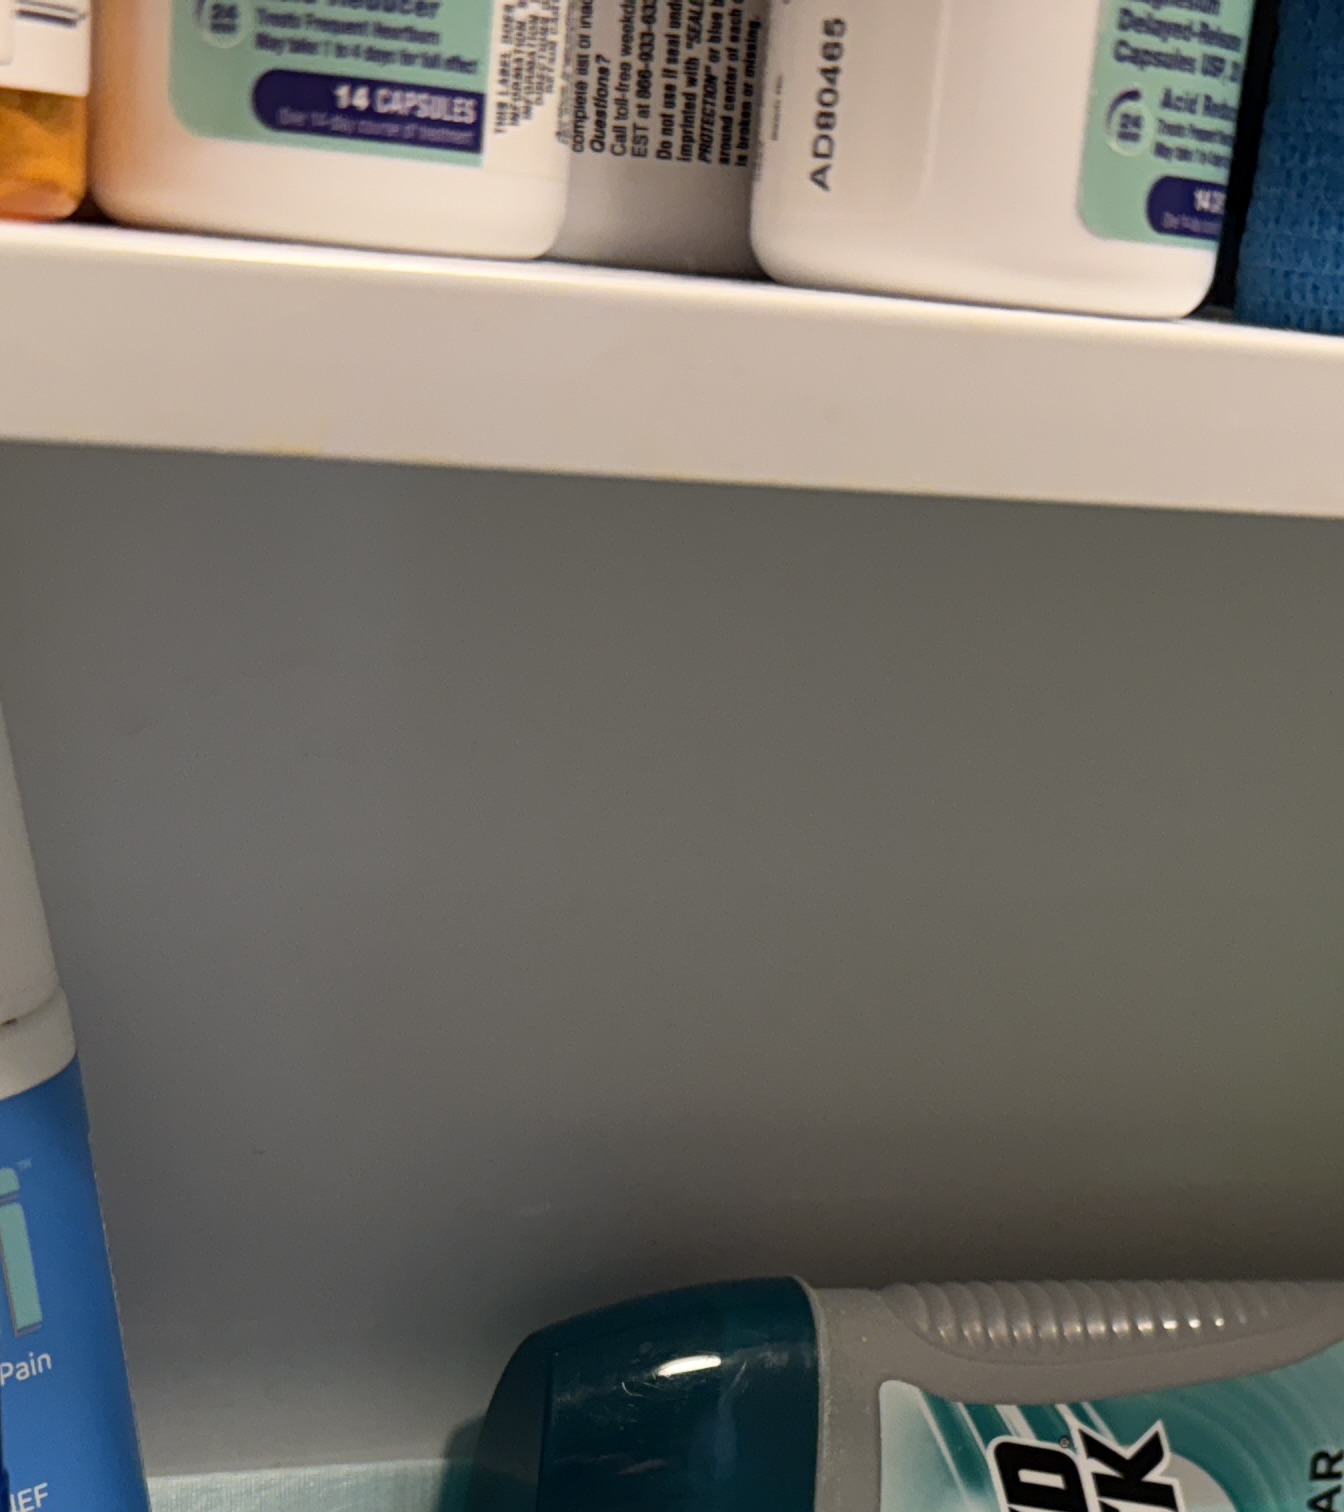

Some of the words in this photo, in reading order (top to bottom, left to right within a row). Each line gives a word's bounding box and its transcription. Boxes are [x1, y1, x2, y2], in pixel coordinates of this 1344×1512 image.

[374, 87, 478, 125] CAPSULES
[589, 53, 612, 154] Questions?
[613, 61, 633, 122] toll-free
[635, 102, 651, 121] at
[659, 113, 674, 138] not
[610, 125, 627, 157] Call
[630, 123, 650, 158] EST
[656, 139, 673, 161] Do
